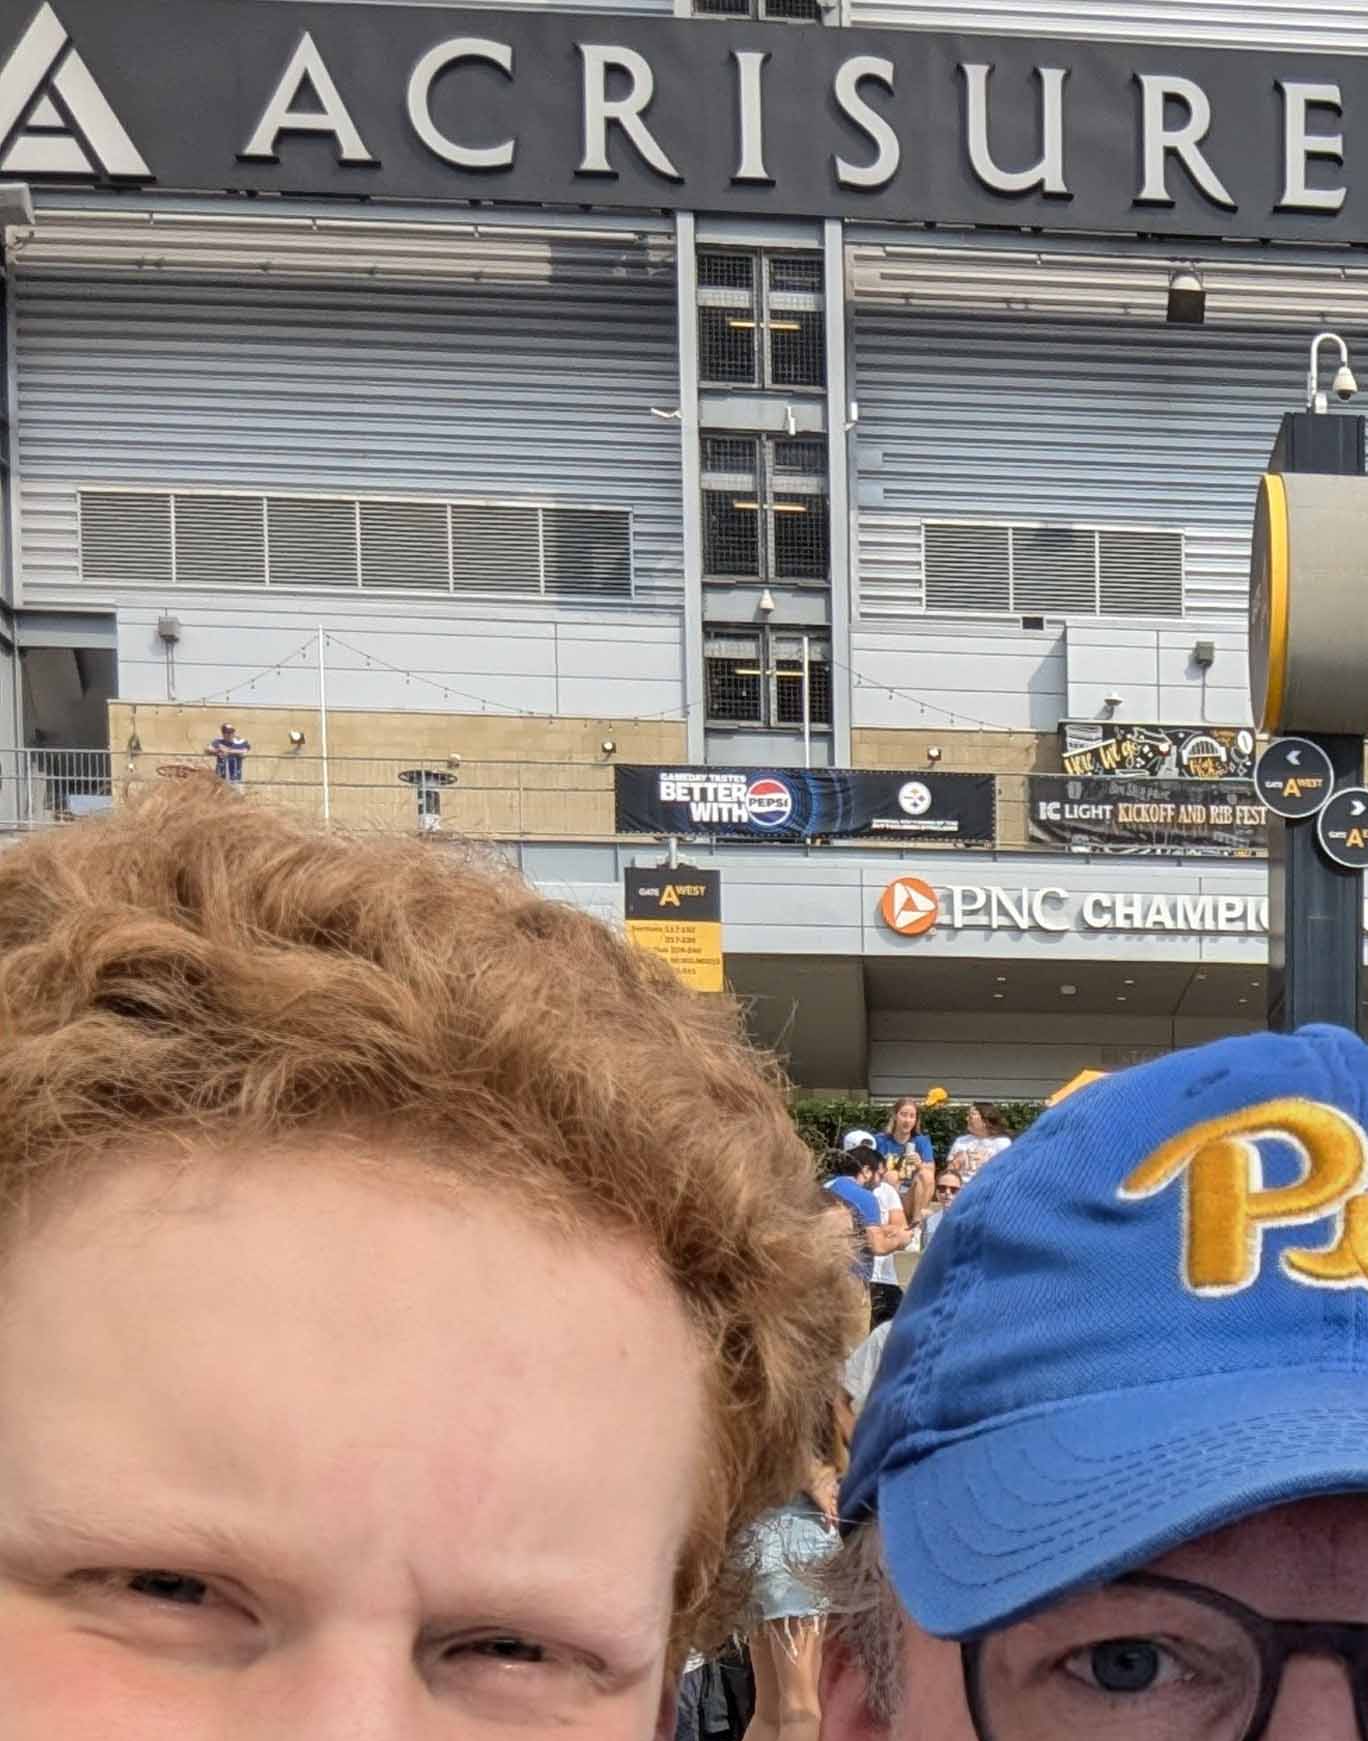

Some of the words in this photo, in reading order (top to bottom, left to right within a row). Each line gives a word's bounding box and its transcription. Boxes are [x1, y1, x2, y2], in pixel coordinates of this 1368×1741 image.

[236, 32, 1348, 215] ACRISURE
[659, 781, 747, 801] BETTER
[1283, 777, 1302, 798] A
[1298, 778, 1324, 788] WEST
[690, 803, 749, 823] WITH
[750, 797, 788, 808] PEPSI
[1039, 802, 1061, 820] IC
[1064, 804, 1113, 820] LIGHT
[1117, 803, 1175, 823] KICKOFF
[1178, 805, 1206, 824] AND
[1209, 805, 1232, 825] RIB
[1235, 806, 1267, 825] FEST
[1345, 828, 1365, 848] A
[659, 884, 681, 907] A
[676, 885, 706, 897] WEST
[947, 885, 1071, 931] PNC
